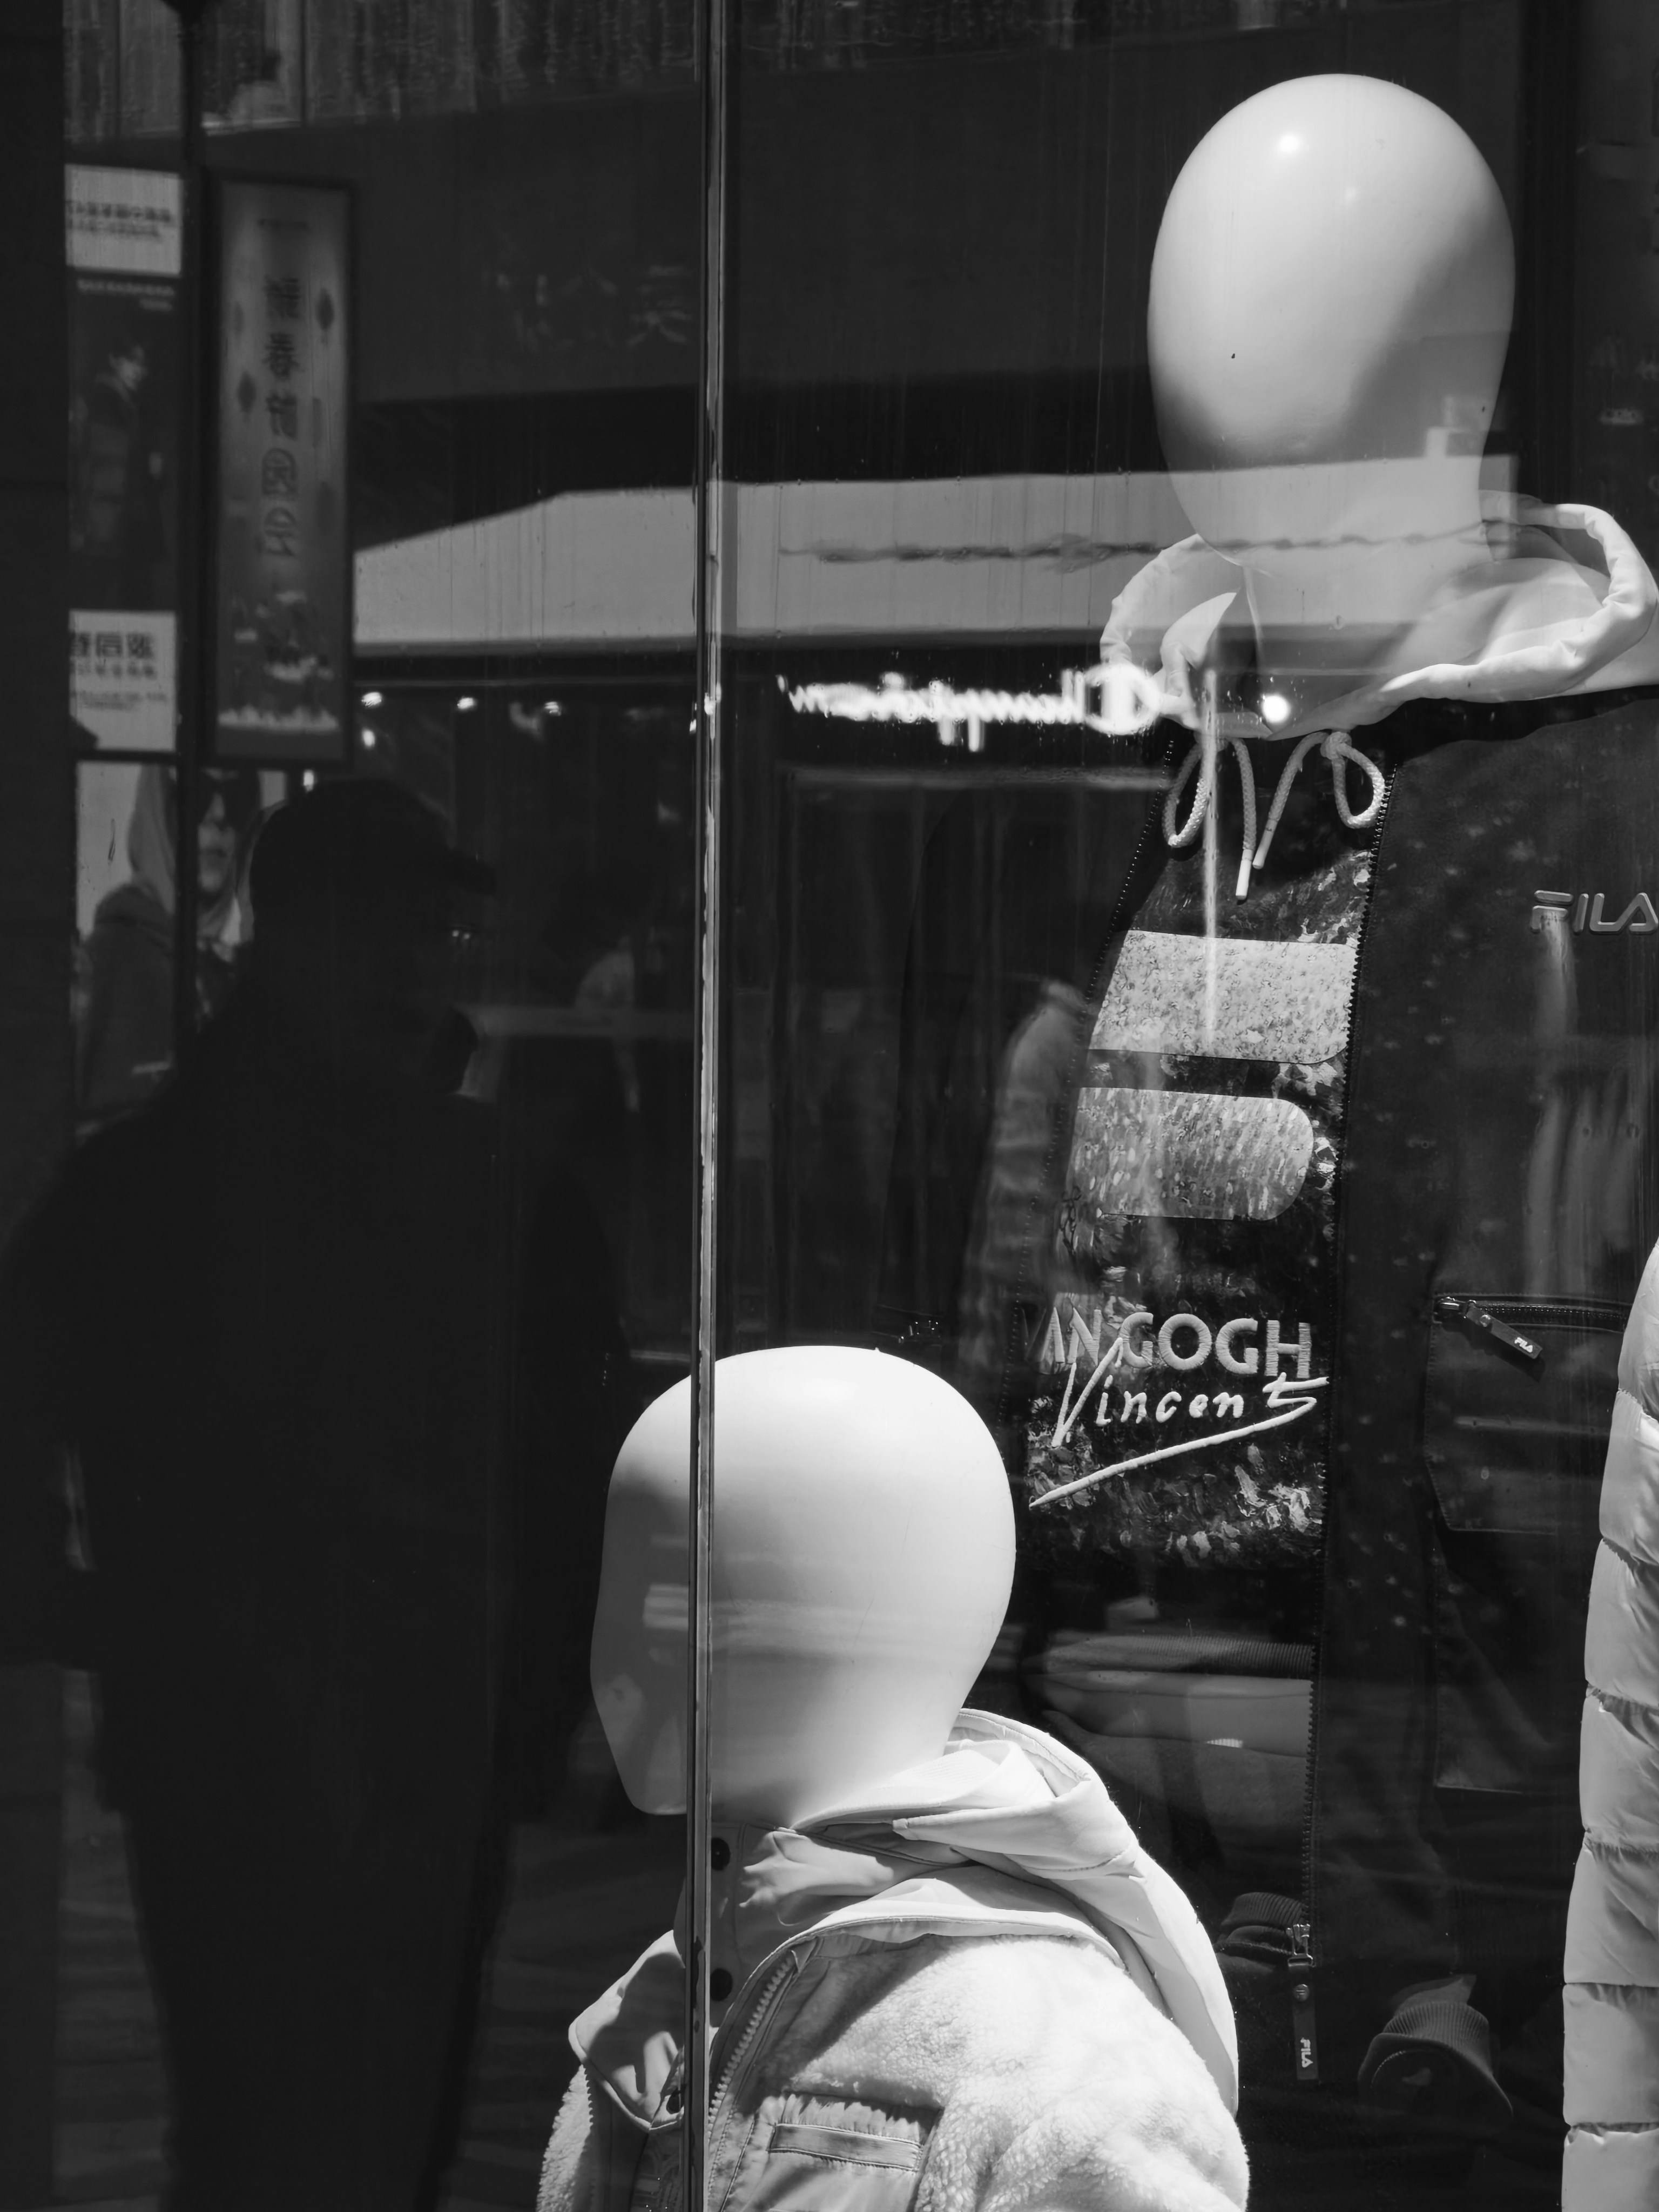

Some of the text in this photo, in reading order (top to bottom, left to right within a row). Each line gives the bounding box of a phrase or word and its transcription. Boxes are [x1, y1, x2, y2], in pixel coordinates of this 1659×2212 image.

[1530, 889, 1659, 935] FILA
[1119, 1312, 1312, 1378] GOGH
[1514, 1337, 1534, 1353] FILA
[1300, 2037, 1313, 2068] FILA
